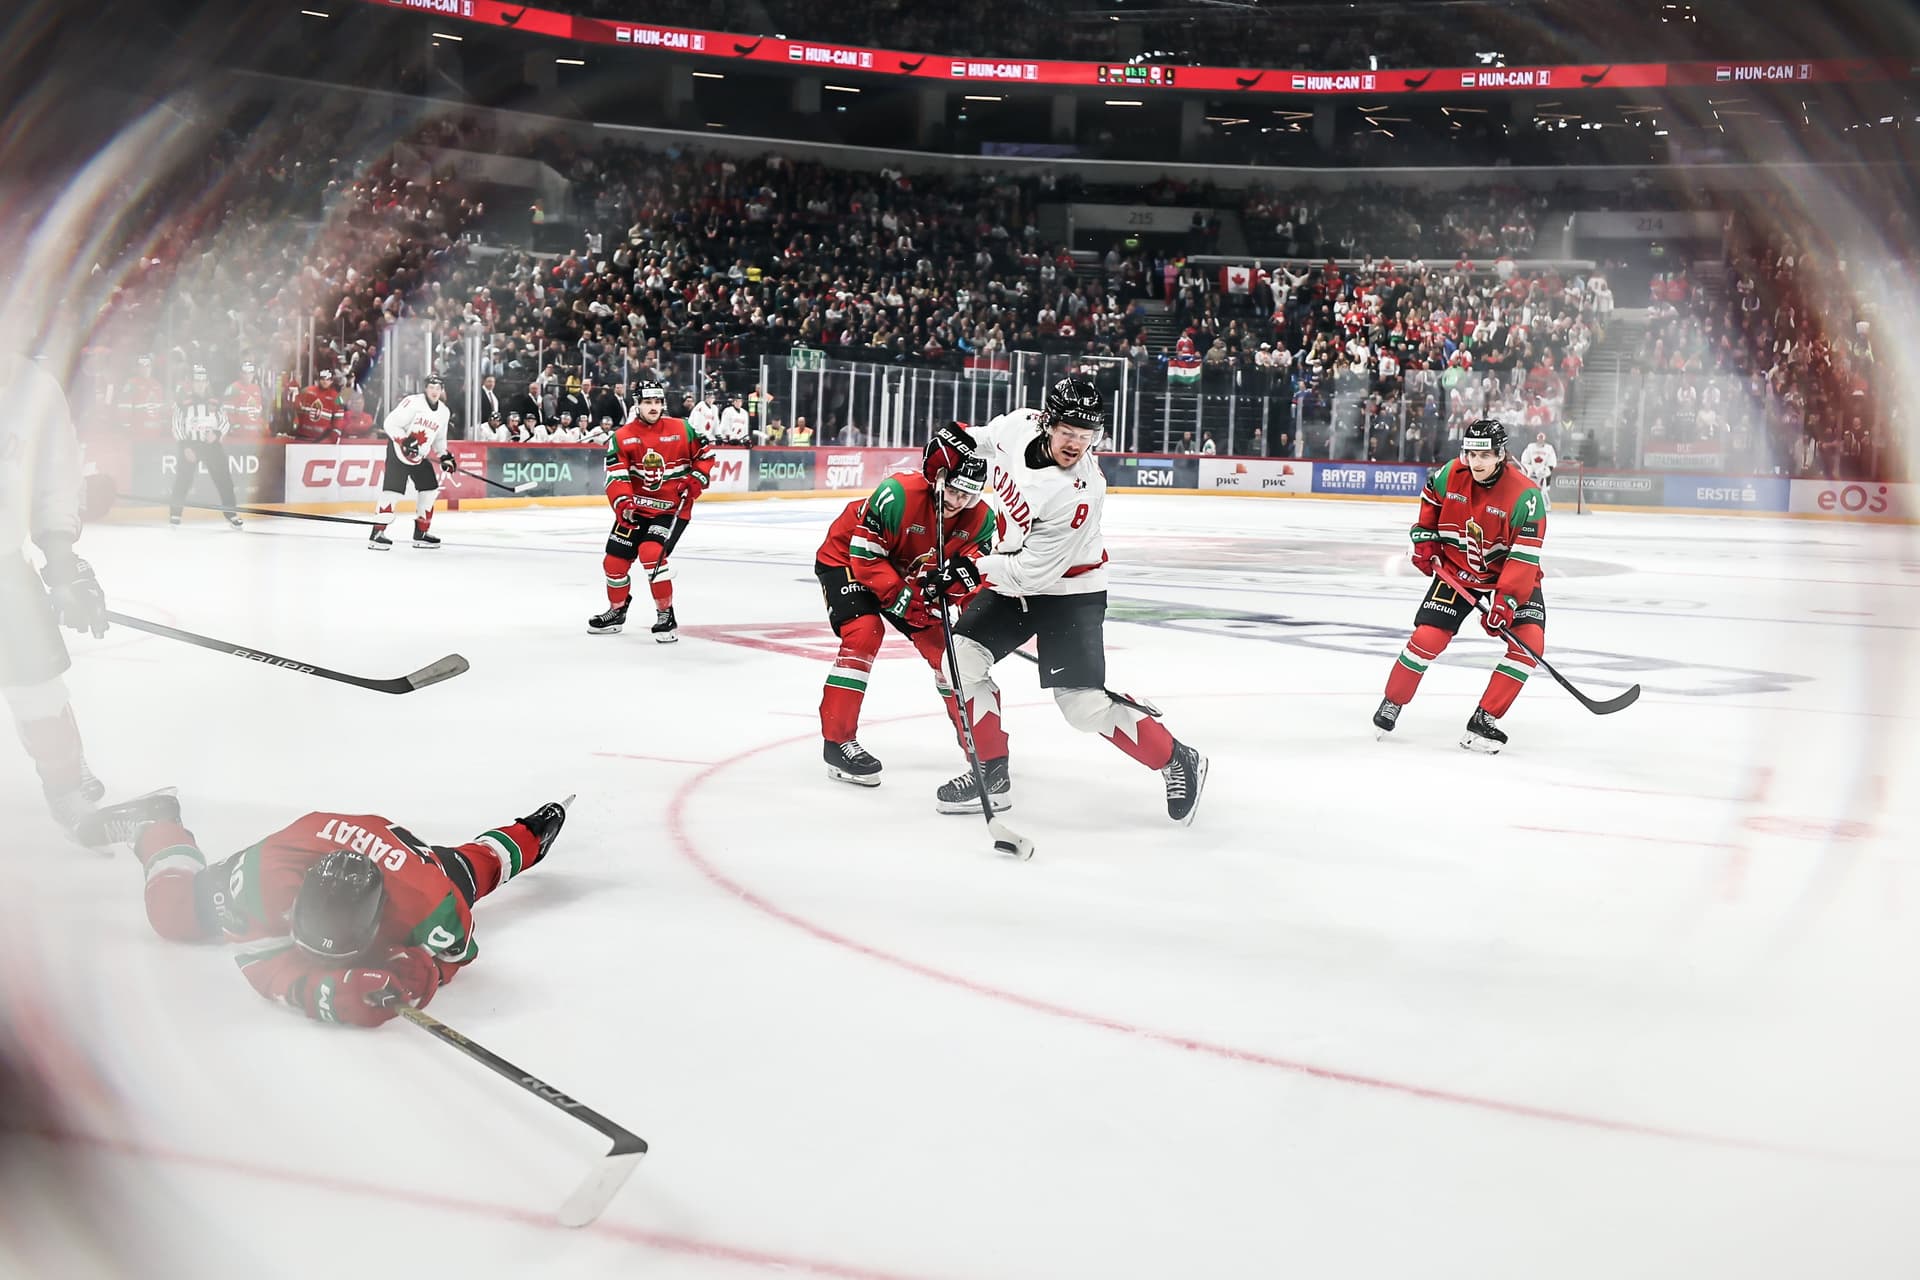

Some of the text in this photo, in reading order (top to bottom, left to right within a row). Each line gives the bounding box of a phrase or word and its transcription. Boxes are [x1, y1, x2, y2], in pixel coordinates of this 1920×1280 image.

[633, 29, 689, 48] HUN-CAN
[805, 47, 858, 65] HUN-CAN
[968, 63, 1022, 78] HUN-CAN
[1735, 65, 1794, 80] HUN-CAN
[1307, 76, 1360, 90] HUN-CAN
[1478, 72, 1533, 87] HUN-CAN
[1128, 211, 1153, 225] 215
[1637, 217, 1663, 231] 214
[414, 416, 440, 432] CANADA
[1077, 411, 1100, 422] TELUS
[162, 455, 260, 474] RLND
[825, 463, 865, 490] sport
[1136, 469, 1174, 486] RSM
[1216, 476, 1240, 487] pwc
[1262, 477, 1287, 489] pwc
[1321, 468, 1367, 483] BAYER
[1374, 470, 1417, 485] BAYER
[1321, 481, 1366, 489] CONSTRUCT
[1374, 483, 1417, 491] PROPERTY
[992, 465, 1032, 536] CANADA
[1696, 487, 1740, 501] ERSTE
[1069, 503, 1090, 530] 8
[231, 648, 315, 674] BAUER
[315, 818, 408, 872] GARAT
[321, 937, 334, 950] 70
